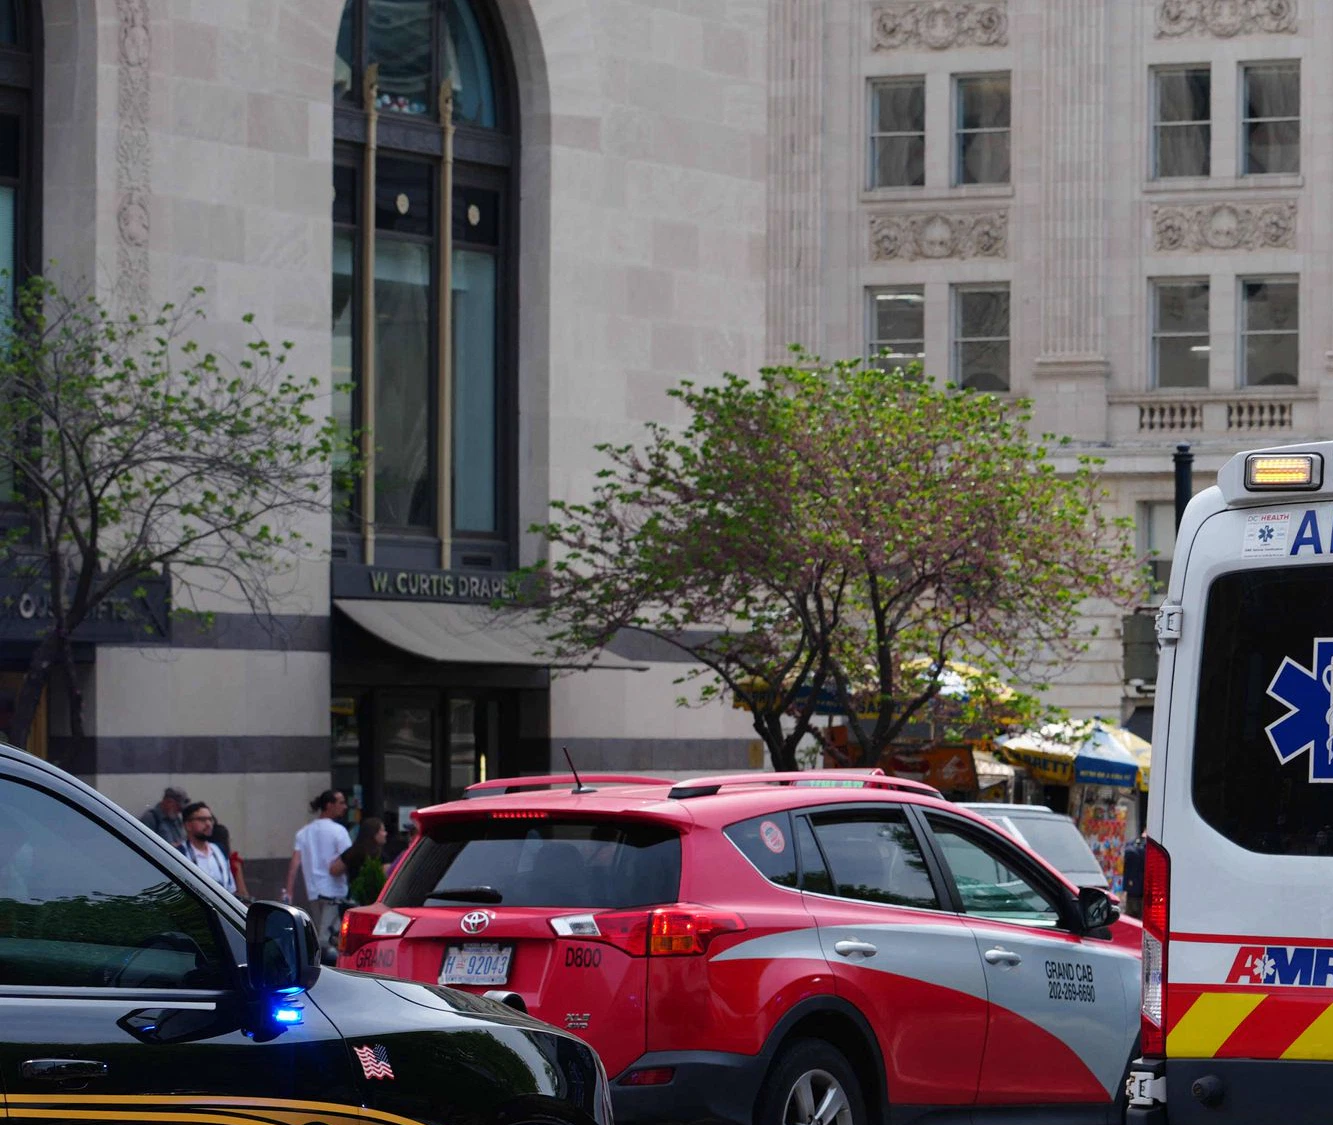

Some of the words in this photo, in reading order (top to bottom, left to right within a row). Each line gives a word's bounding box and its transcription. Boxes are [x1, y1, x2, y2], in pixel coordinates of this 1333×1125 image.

[1261, 513, 1289, 521] HEALTH
[370, 571, 393, 593] W.
[397, 573, 454, 595] CURTIS
[356, 948, 394, 968] GRAND
[445, 956, 456, 974] H
[467, 956, 508, 975] 92043
[565, 947, 601, 968] D800
[1045, 961, 1074, 981] GRAND
[1075, 963, 1093, 983] CAB
